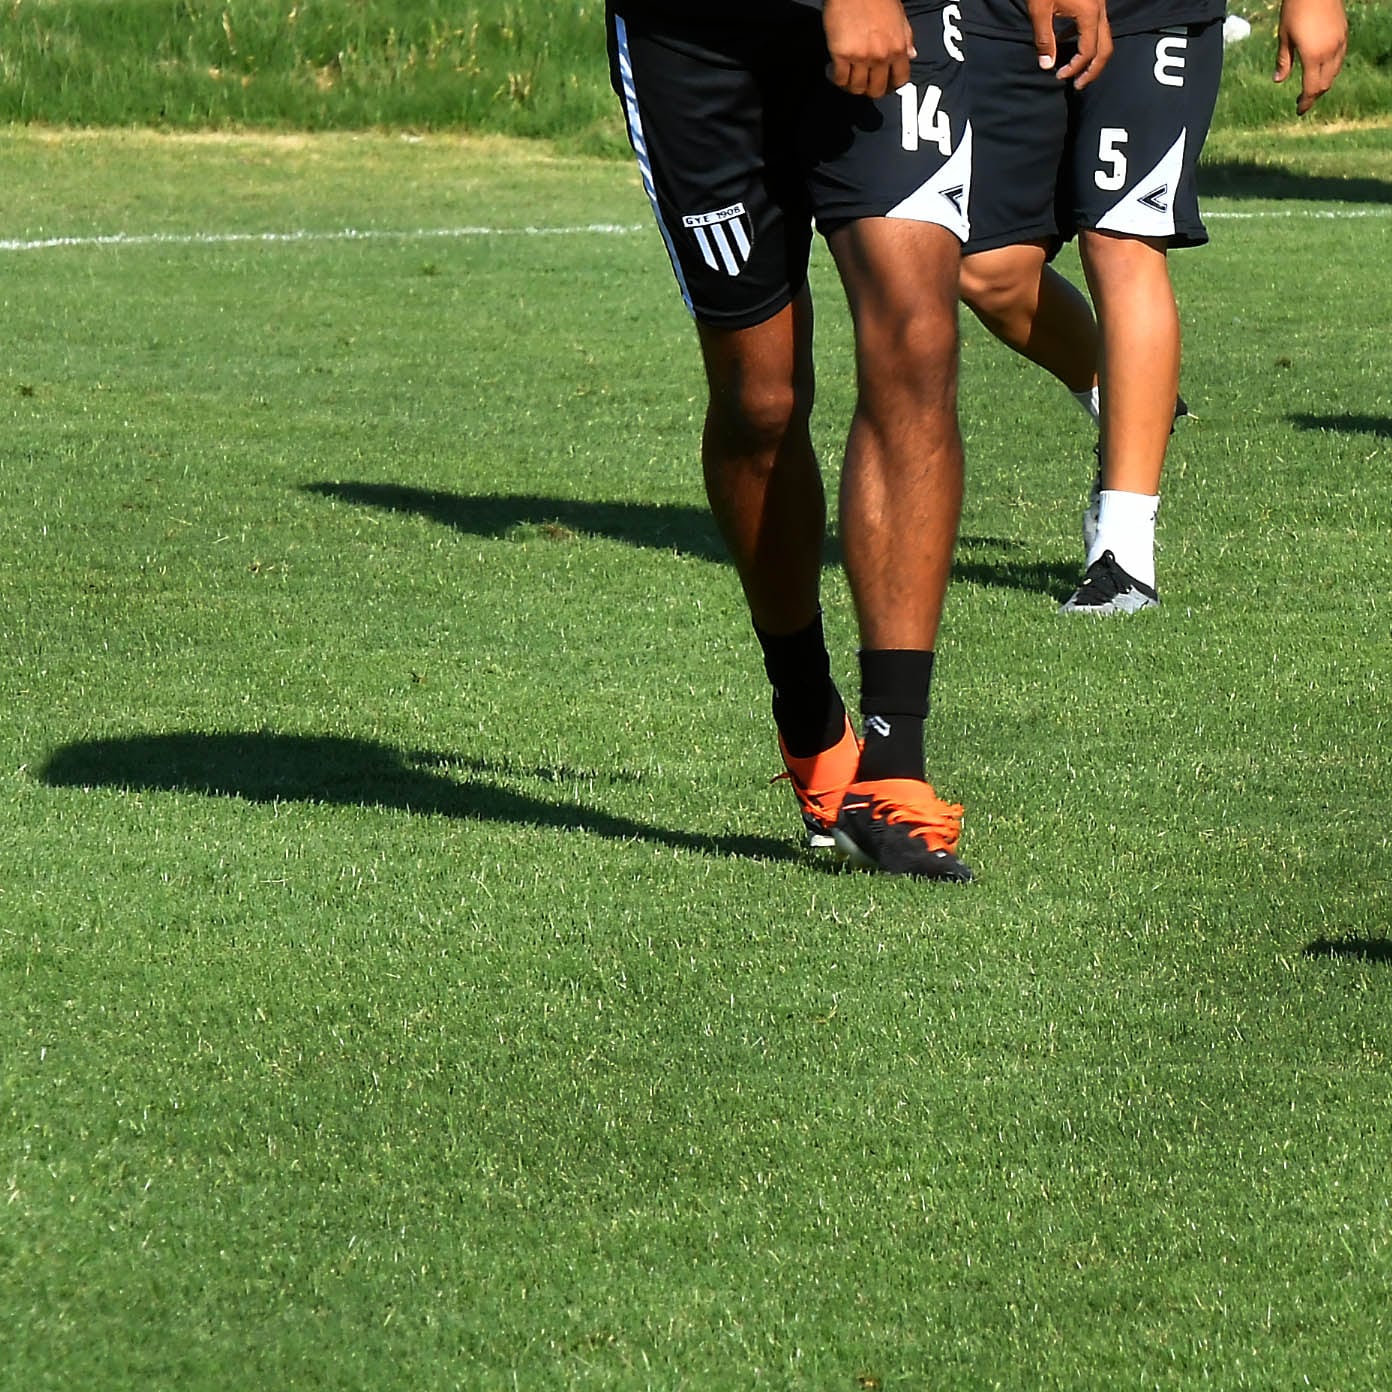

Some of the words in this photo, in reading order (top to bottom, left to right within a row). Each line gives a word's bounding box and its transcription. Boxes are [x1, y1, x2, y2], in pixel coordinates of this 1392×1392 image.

[895, 82, 952, 156] 14
[1094, 127, 1129, 191] 5
[685, 215, 709, 225] GYE
[716, 206, 741, 219] 1908
